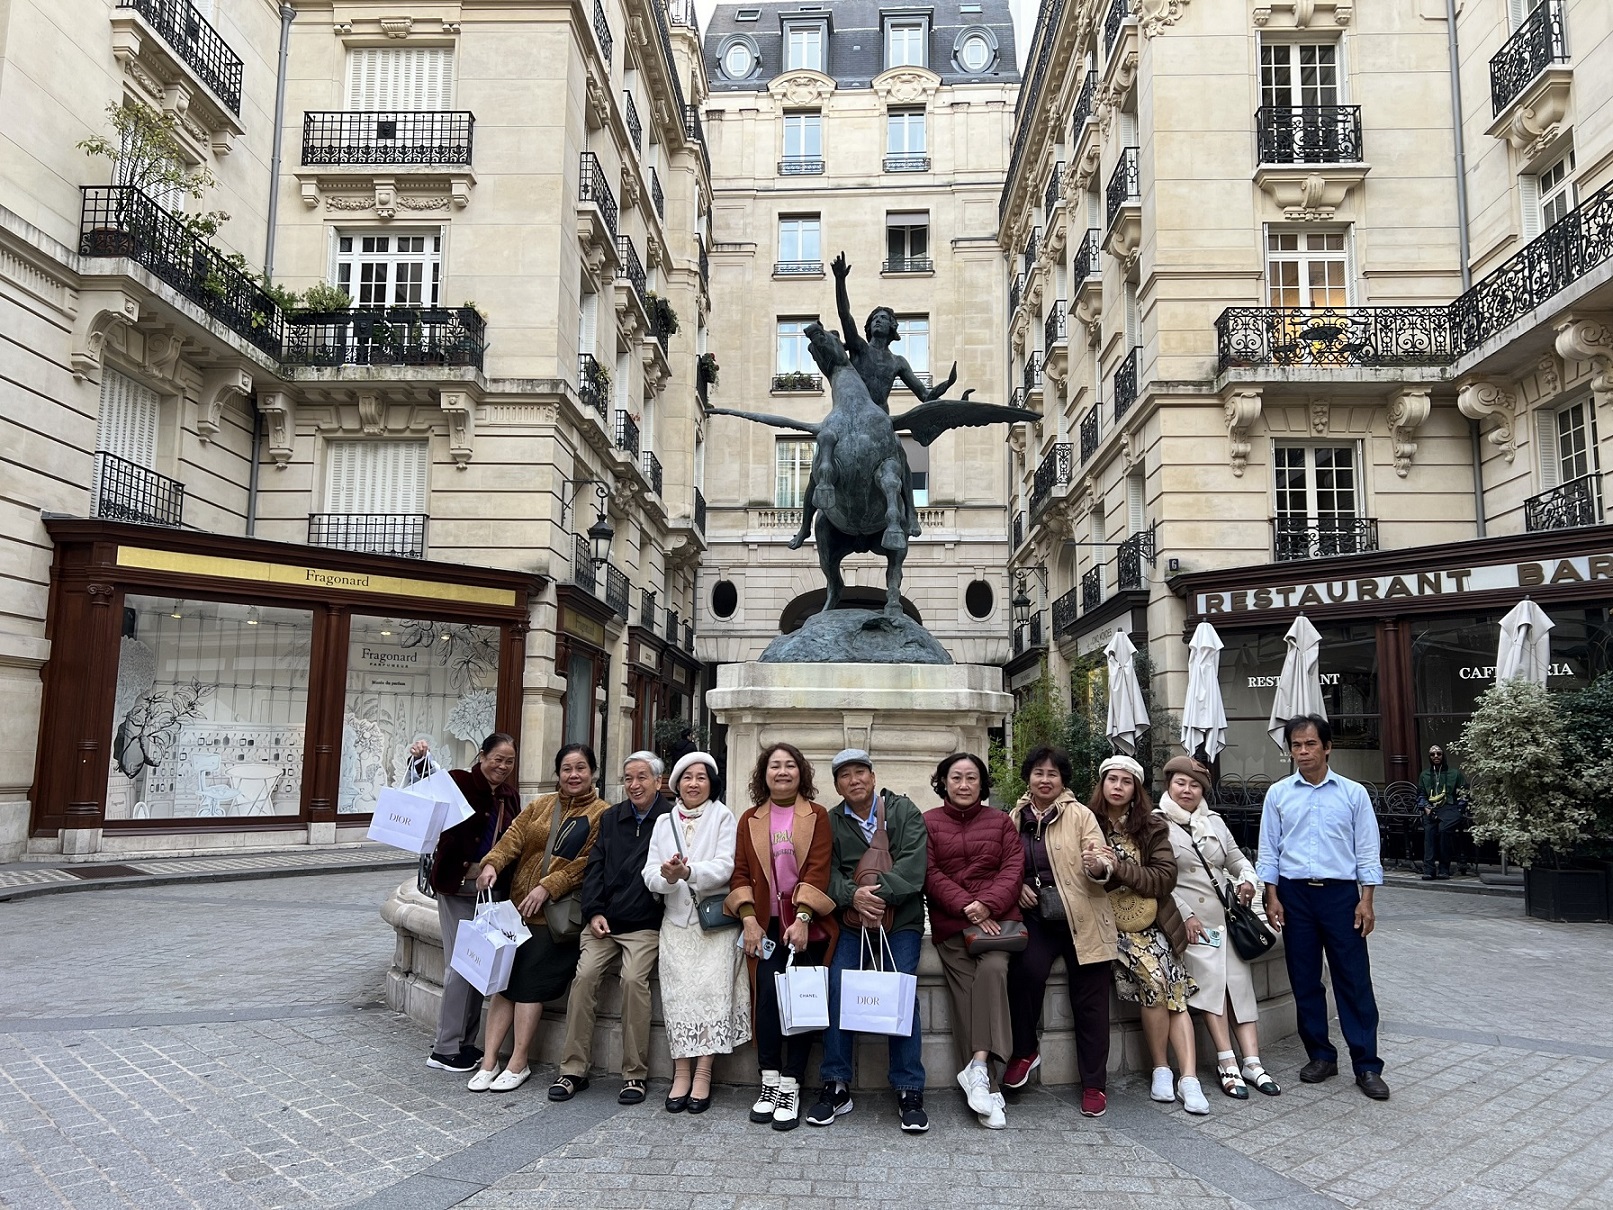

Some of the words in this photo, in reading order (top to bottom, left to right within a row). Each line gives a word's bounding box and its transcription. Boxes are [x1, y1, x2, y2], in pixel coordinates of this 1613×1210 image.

[305, 569, 370, 587] Fragonard
[1205, 569, 1472, 614] RESTAURANT
[1517, 555, 1613, 587] BAR
[361, 648, 417, 663] Fragonard
[389, 813, 412, 826] DIOR
[857, 996, 880, 1006] DIOR
